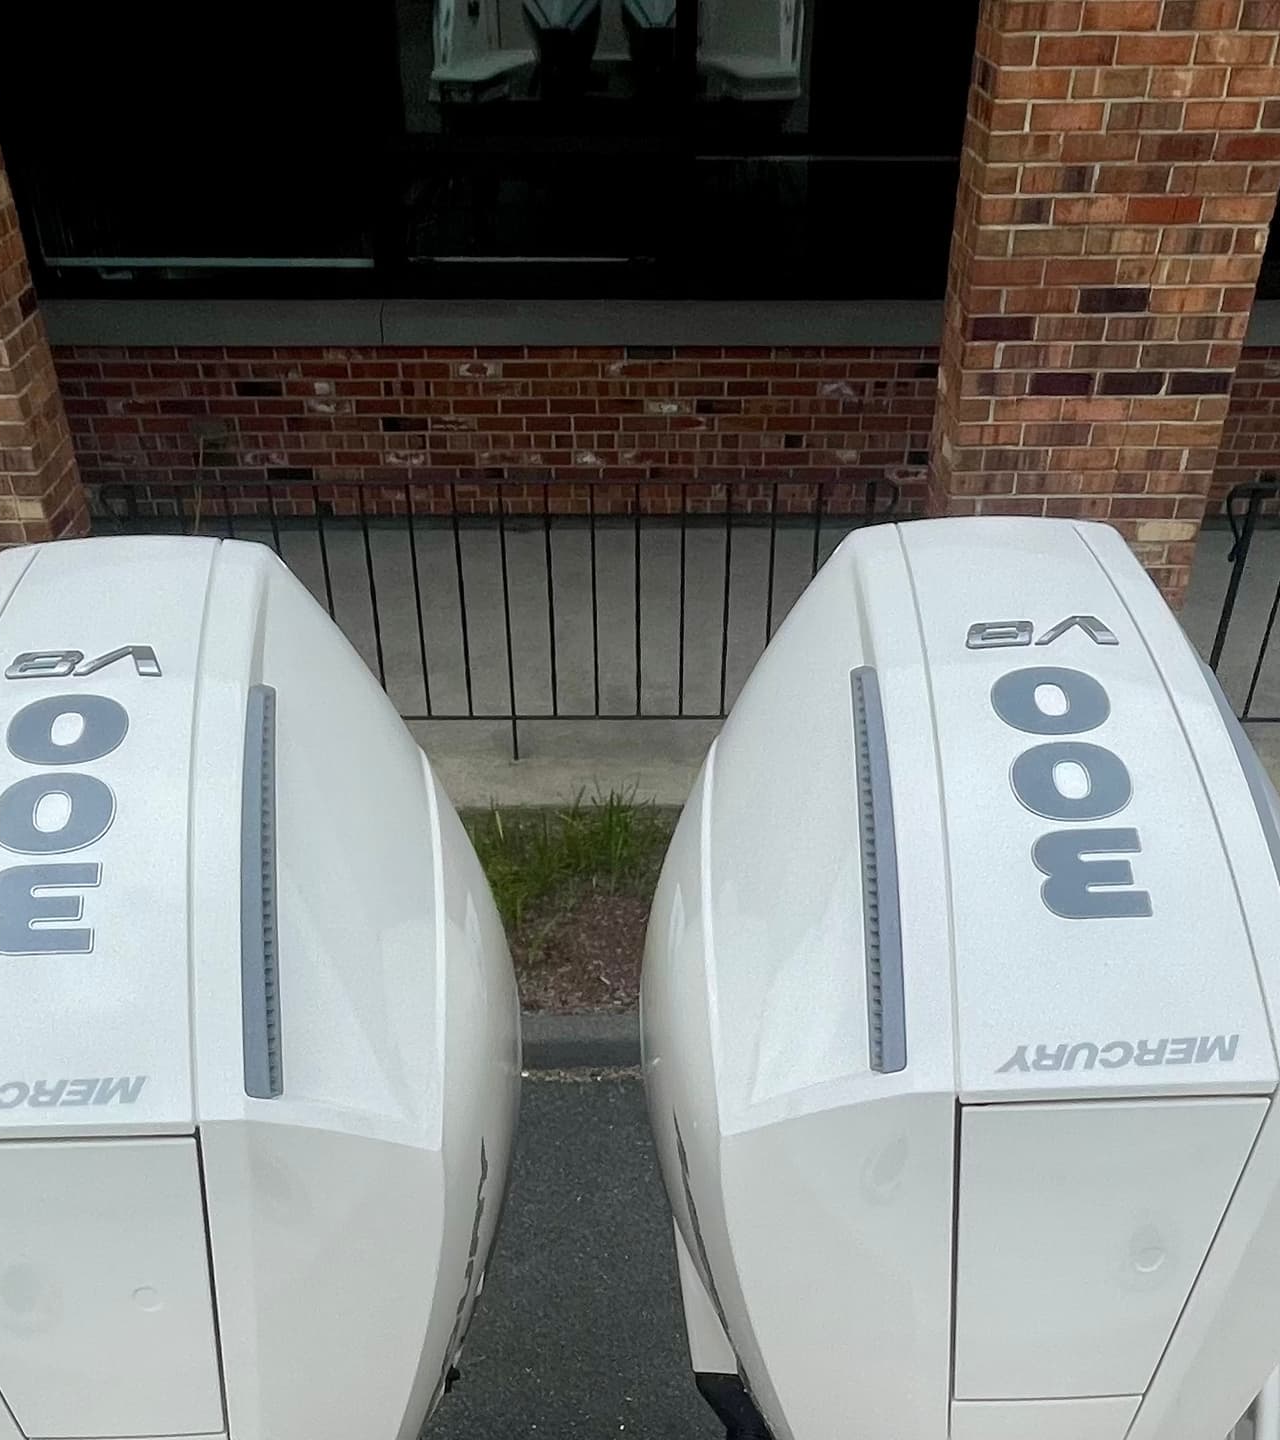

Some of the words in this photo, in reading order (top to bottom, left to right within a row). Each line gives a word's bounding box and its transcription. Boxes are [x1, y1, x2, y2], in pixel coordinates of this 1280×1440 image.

[5, 645, 162, 679] V8
[990, 666, 1153, 919] 300
[994, 1034, 1239, 1073] MERCURY
